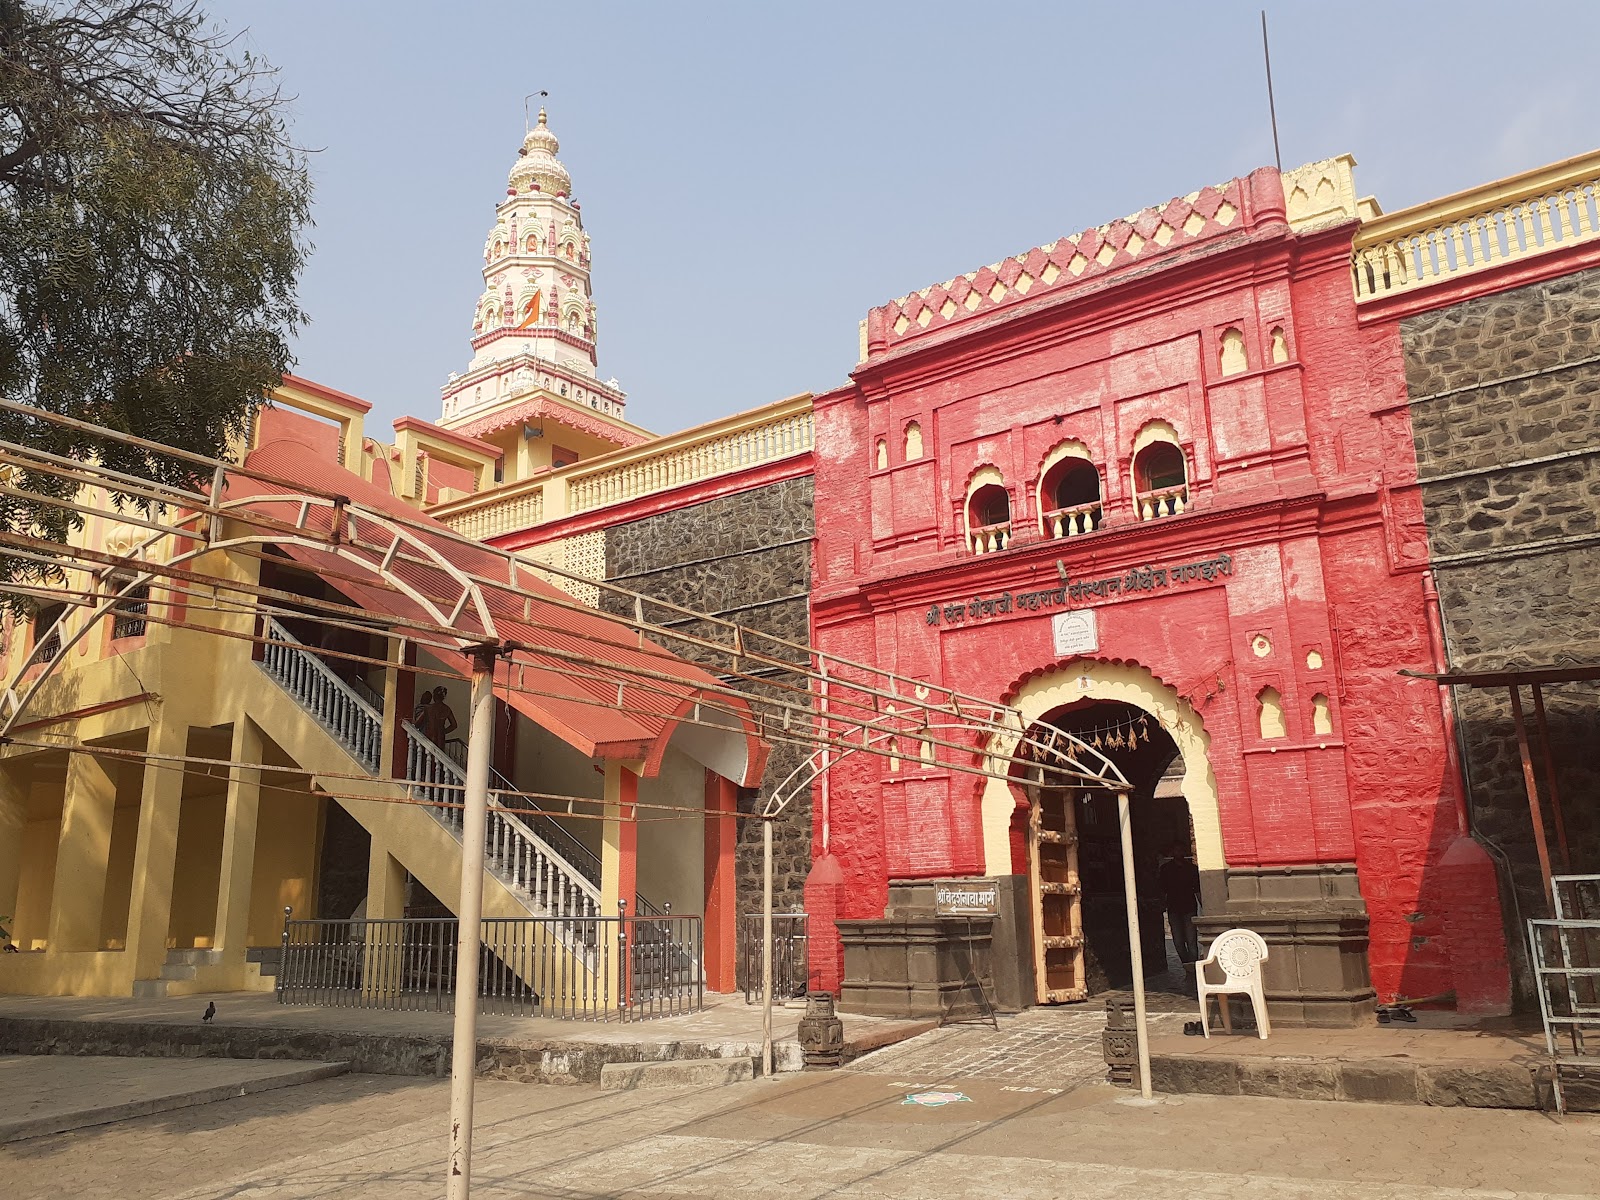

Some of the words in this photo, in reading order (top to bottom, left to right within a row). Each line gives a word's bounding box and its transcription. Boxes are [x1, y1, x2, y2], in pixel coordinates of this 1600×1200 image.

[926, 604, 940, 626] श्री
[944, 603, 965, 624] संत
[969, 595, 1013, 619] गोमाजी
[1016, 586, 1067, 611] महाराज
[1068, 578, 1121, 602] संस्थान
[1125, 564, 1168, 592] श्रीक्षेत्र
[1171, 553, 1232, 582] नागझरी
